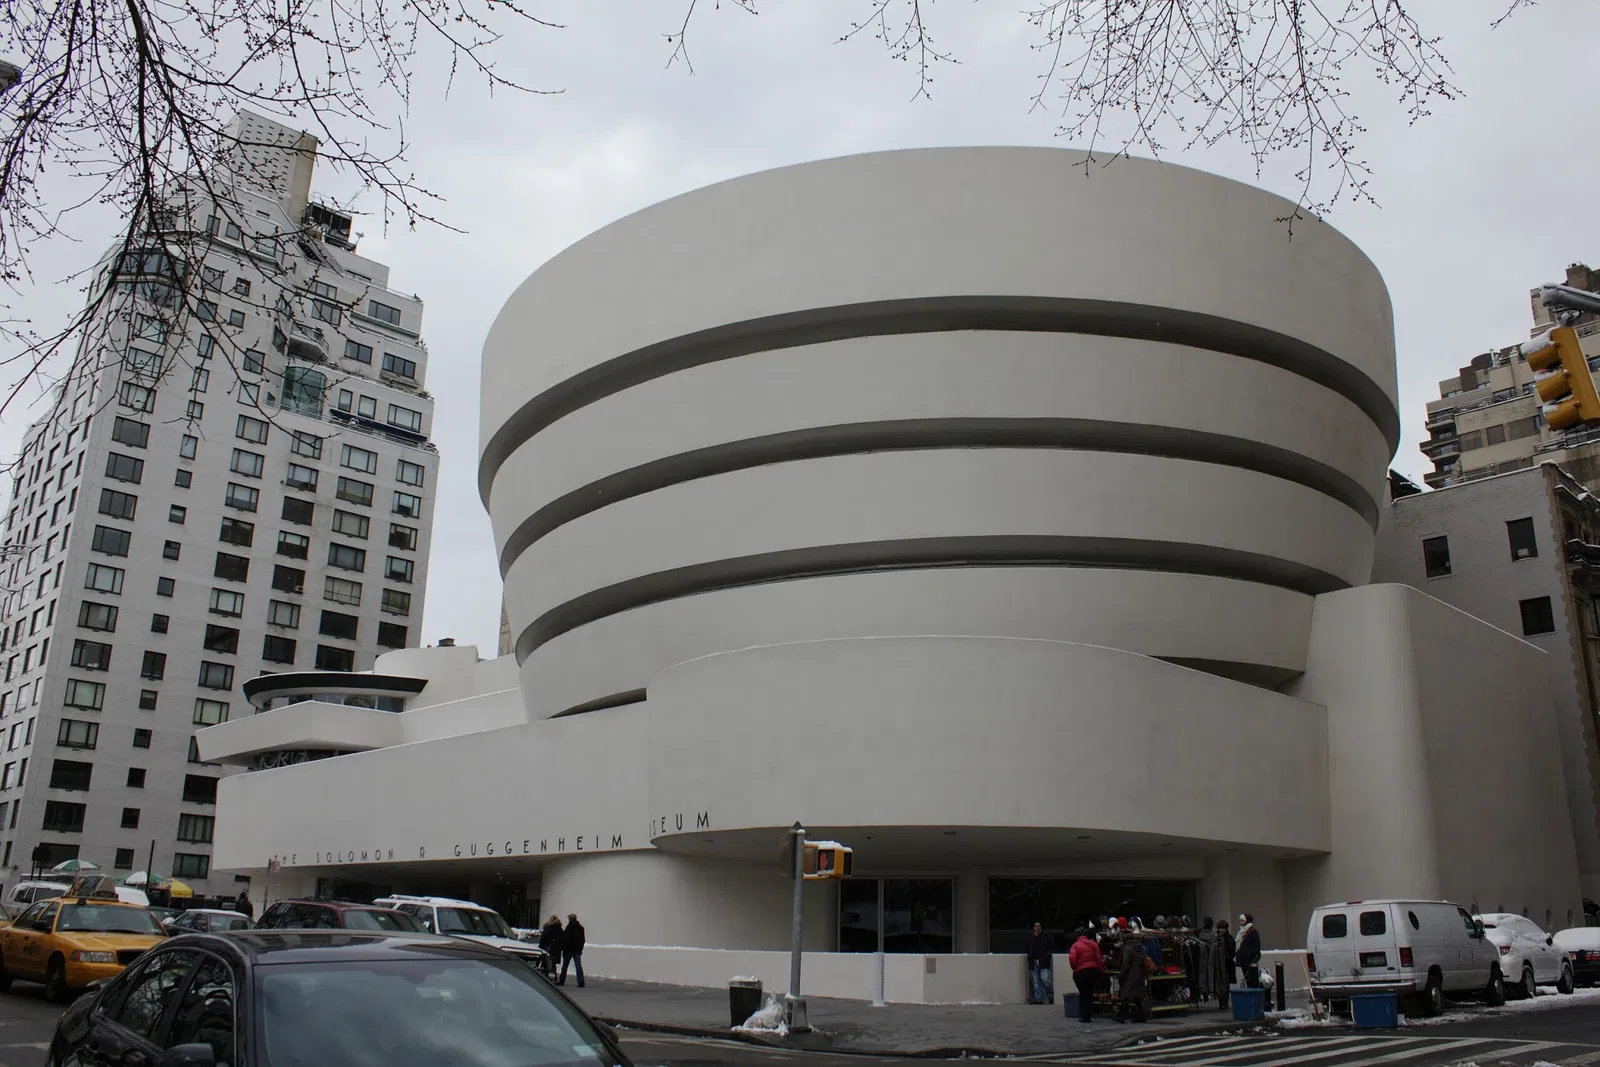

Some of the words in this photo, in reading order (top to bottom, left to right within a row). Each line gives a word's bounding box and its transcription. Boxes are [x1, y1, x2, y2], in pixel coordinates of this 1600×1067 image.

[274, 853, 297, 865] THE
[316, 849, 394, 863] SOLOMON
[420, 847, 425, 859] R
[454, 834, 623, 857] GUGGENHEIM
[648, 811, 710, 838] SEUM
